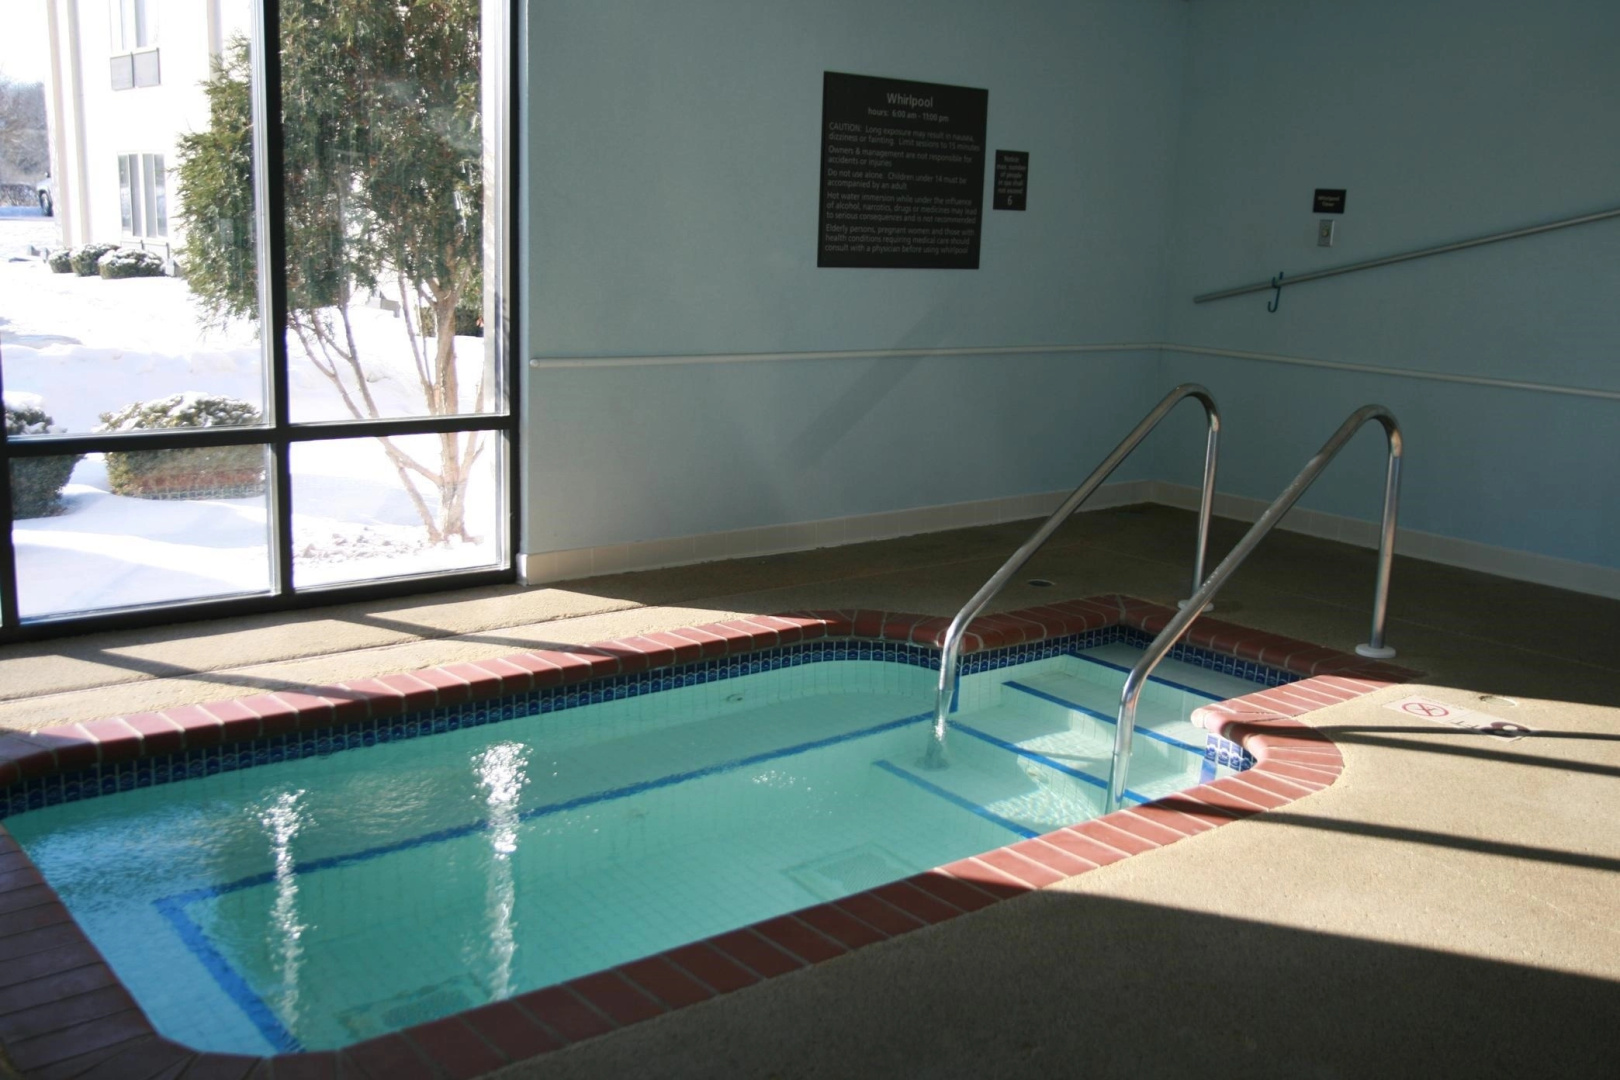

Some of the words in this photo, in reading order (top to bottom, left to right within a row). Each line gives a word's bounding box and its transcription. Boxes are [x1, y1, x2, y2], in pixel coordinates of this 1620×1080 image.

[887, 93, 933, 108] Whirlpool
[892, 109, 906, 118] 6:00
[922, 112, 938, 121] 11:00
[939, 115, 949, 123] pm
[866, 125, 882, 135] Long
[883, 128, 911, 138] exposure
[913, 130, 925, 139] may
[927, 130, 943, 139] result
[829, 132, 858, 141] dizziness
[899, 138, 914, 146] Limit
[916, 139, 939, 148] sessions
[828, 145, 854, 154] Owners
[856, 147, 860, 155] &
[862, 147, 904, 160] management
[929, 152, 962, 164] responsible
[964, 155, 972, 163] for
[828, 156, 858, 164] accidents
[828, 168, 837, 176] Do
[839, 169, 850, 177] not
[888, 172, 914, 181] Children
[916, 174, 933, 182] under
[944, 175, 958, 183] must
[959, 176, 967, 184] be
[827, 179, 870, 189] accompanied
[872, 181, 880, 190] by
[827, 191, 839, 199] Hot
[841, 192, 860, 200] water
[862, 193, 895, 202] immersion
[945, 197, 972, 205] influence
[1008, 195, 1012, 206] 6
[836, 202, 861, 211] alcohol,
[894, 204, 911, 214] drugs
[859, 214, 902, 223] consequences
[826, 224, 848, 233] Elderly
[850, 226, 875, 234] persons,
[878, 226, 906, 235] pregnant
[848, 234, 881, 242] conditions
[883, 236, 911, 245] requiring
[872, 245, 900, 254] physician
[923, 246, 939, 255] using
